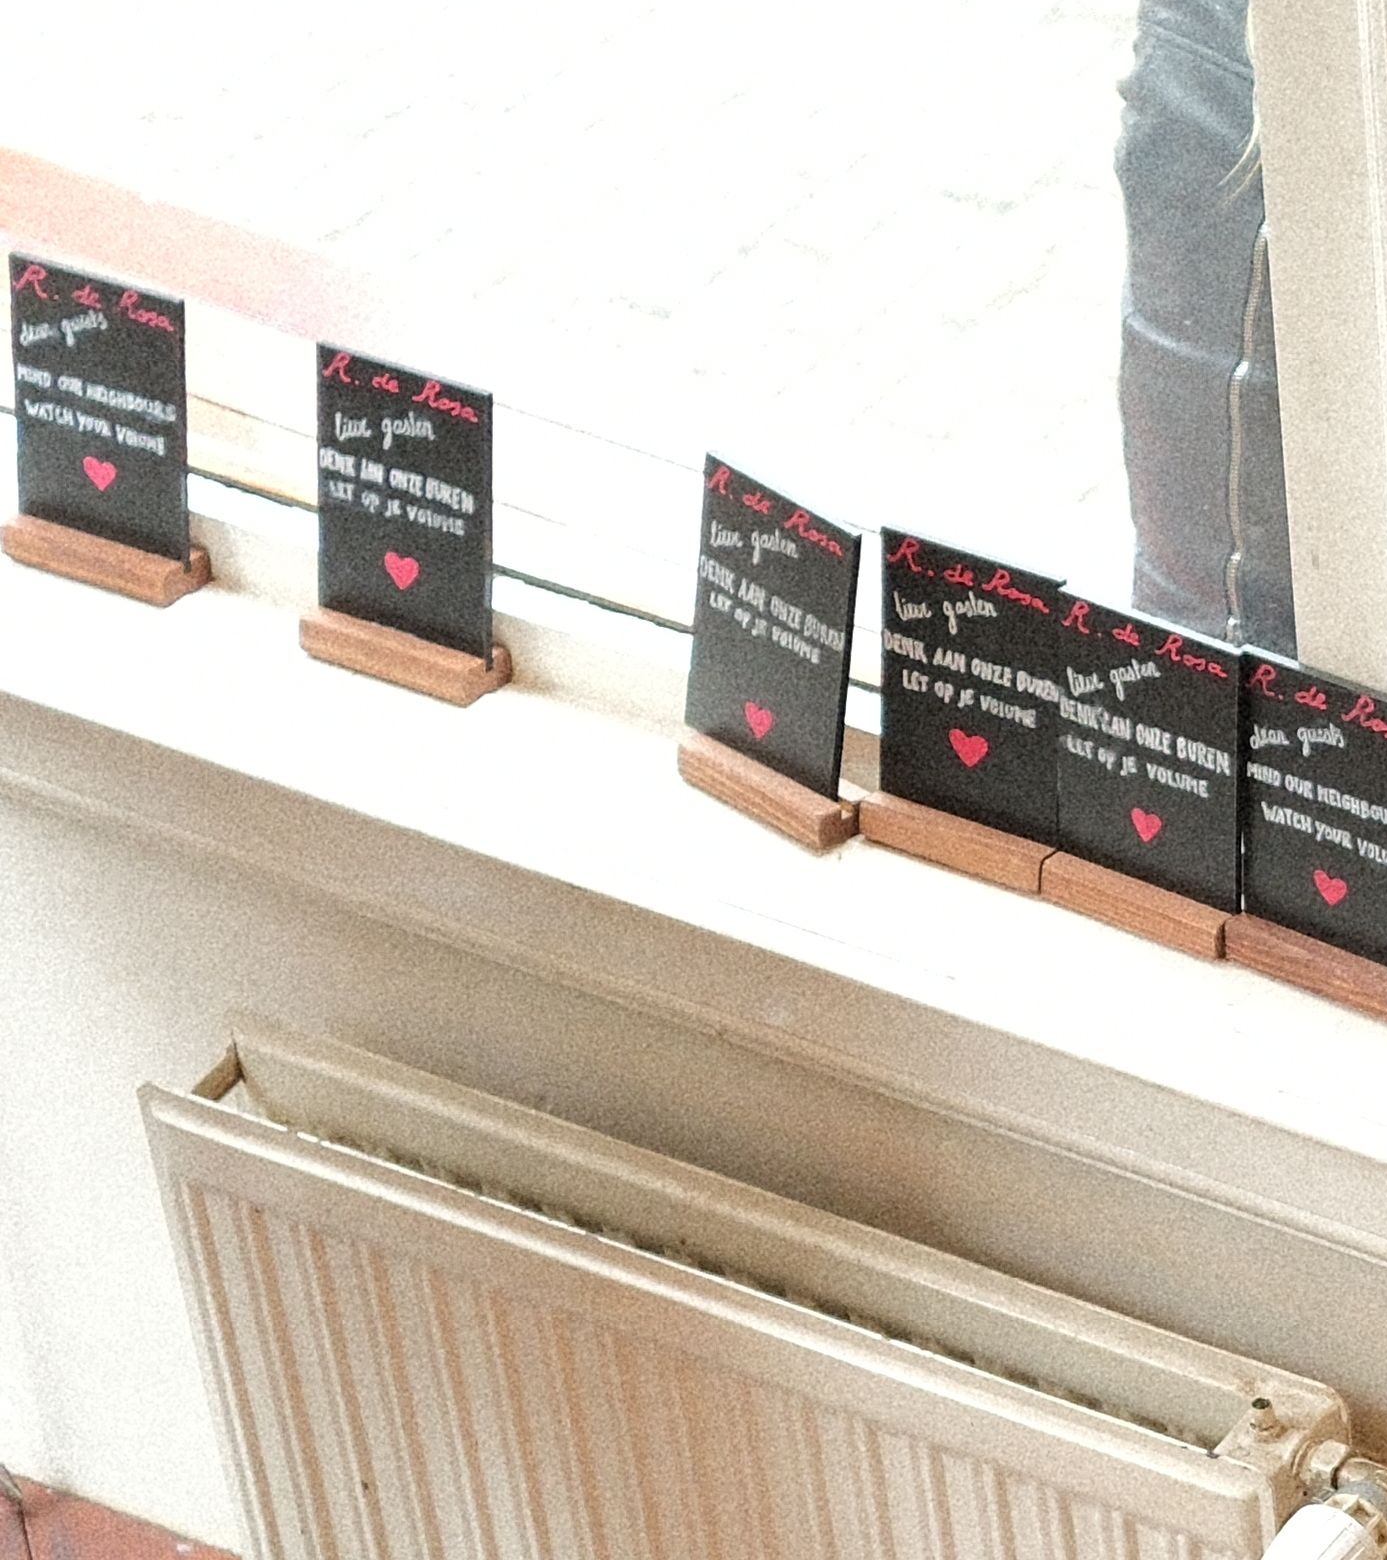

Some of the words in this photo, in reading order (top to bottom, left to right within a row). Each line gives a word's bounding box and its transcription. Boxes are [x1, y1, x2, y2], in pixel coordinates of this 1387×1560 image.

[13, 265, 59, 300] R.
[72, 285, 102, 309] de
[117, 291, 174, 332] Rosa
[322, 351, 360, 386] R.
[372, 373, 400, 393] de
[411, 380, 478, 424] Rosa
[707, 465, 734, 500] R.
[742, 492, 774, 515] de
[784, 509, 844, 558] Rosa
[700, 554, 735, 595] DENK
[738, 577, 766, 613] AAN
[770, 595, 803, 631] ONZE
[803, 613, 846, 653] BUREN
[886, 536, 935, 577] R.
[943, 563, 975, 587] de
[981, 568, 1050, 614] Rosa
[709, 590, 733, 612] LET
[734, 607, 752, 629] OP
[751, 618, 768, 638] JE
[771, 625, 821, 665] VOLUME
[1061, 600, 1102, 637] R.
[1111, 623, 1141, 647] de
[1154, 634, 1229, 679] Rosa
[883, 628, 928, 665] DENK
[932, 646, 966, 674] AAN
[970, 657, 1013, 688] ONZE
[1016, 669, 1060, 704] BUREN
[902, 668, 930, 693] LET
[934, 680, 955, 704] OP
[957, 688, 975, 709] JE
[979, 694, 1037, 729] VOLUME
[1248, 664, 1284, 701] R.
[1294, 686, 1327, 711] de
[1060, 695, 1098, 730] DENK
[1099, 706, 1131, 741] AAN
[1135, 722, 1172, 756] ONZE
[1176, 736, 1232, 777] BUREN
[1065, 733, 1094, 760] LET
[1097, 746, 1116, 771] OP
[1120, 756, 1138, 777] JE
[1146, 762, 1210, 799] VOLUME
[1247, 761, 1281, 787] MIND
[1284, 774, 1314, 801] OUR
[1261, 800, 1313, 834] WATCH
[1314, 820, 1353, 850] YOUR
